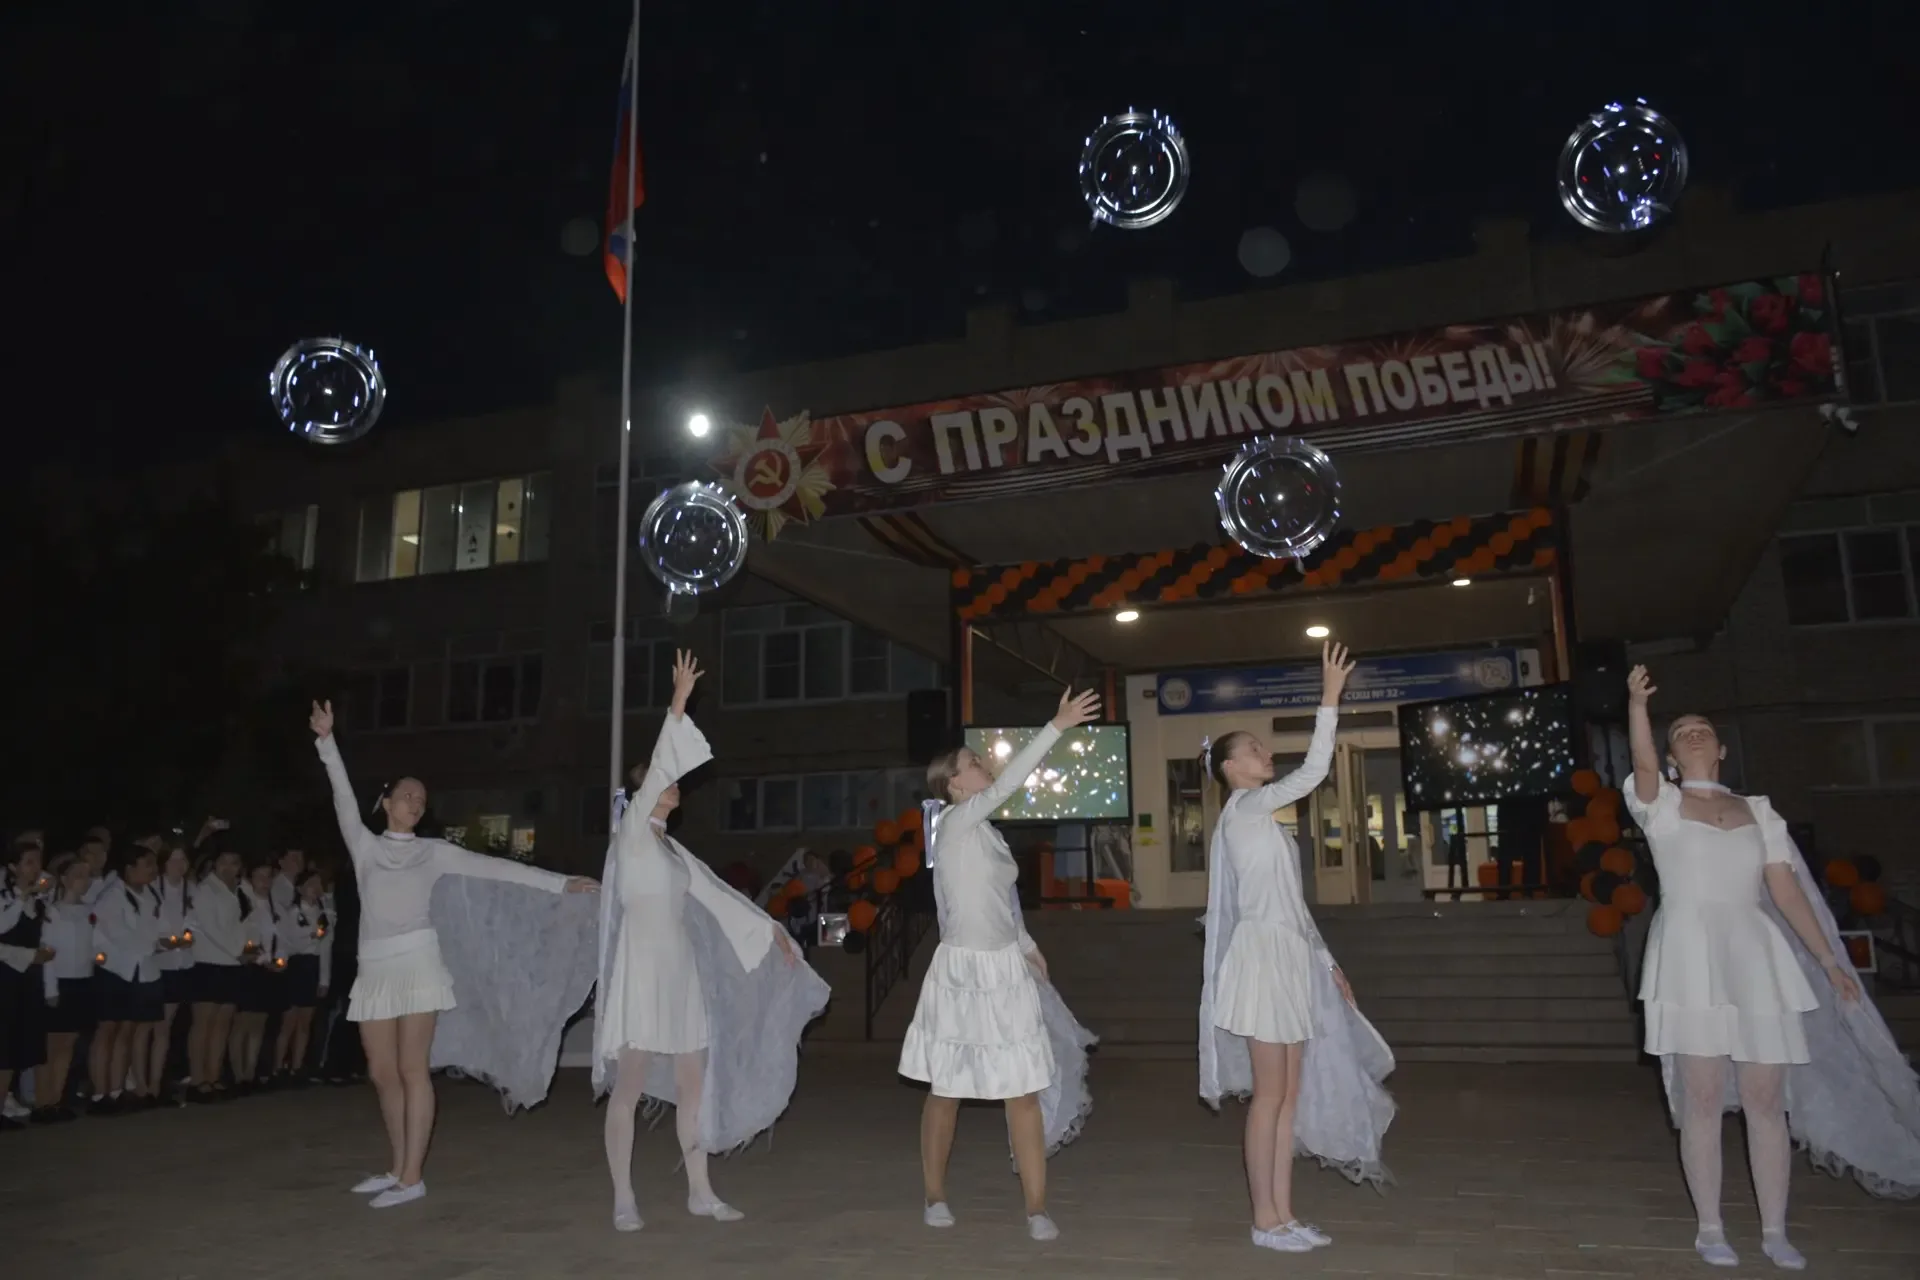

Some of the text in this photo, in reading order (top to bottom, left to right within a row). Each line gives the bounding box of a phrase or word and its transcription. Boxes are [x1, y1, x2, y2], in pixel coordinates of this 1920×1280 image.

[863, 343, 1556, 484] С ПРАЗДНИКОМ ПОБЕДЫ!
